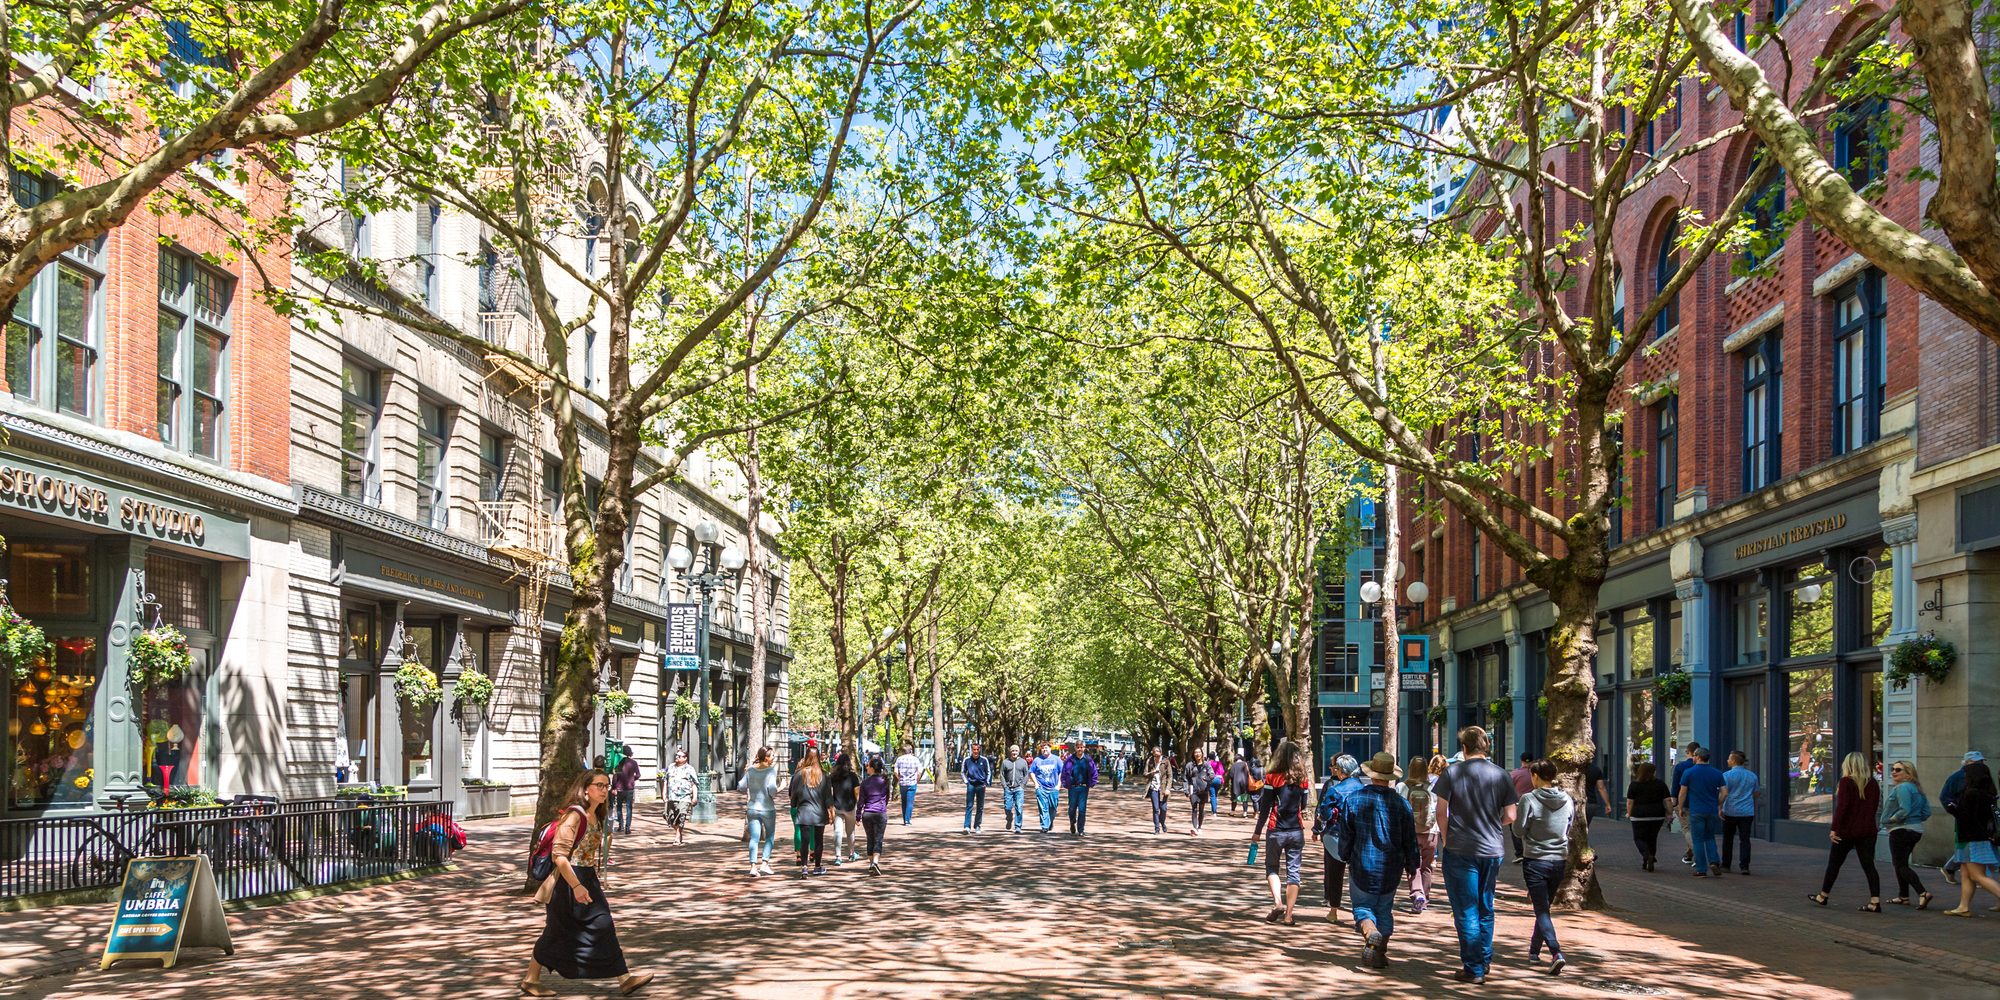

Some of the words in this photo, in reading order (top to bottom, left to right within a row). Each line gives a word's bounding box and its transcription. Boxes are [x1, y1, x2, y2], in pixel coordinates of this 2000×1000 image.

[0, 465, 109, 514] SHOUSE
[120, 496, 205, 537] STUDIO
[1734, 532, 1787, 560] CHRISTIAN
[1789, 513, 1847, 544] GREVSTAD
[381, 565, 418, 583] FREDERICK
[421, 576, 444, 589] HOLMES
[446, 583, 458, 594] AND
[460, 586, 484, 600] COMPANY
[670, 607, 683, 653] SQUARE
[683, 607, 696, 653] PIONEER
[125, 898, 180, 911] UMBRIA
[144, 890, 166, 898] CAFFÈ
